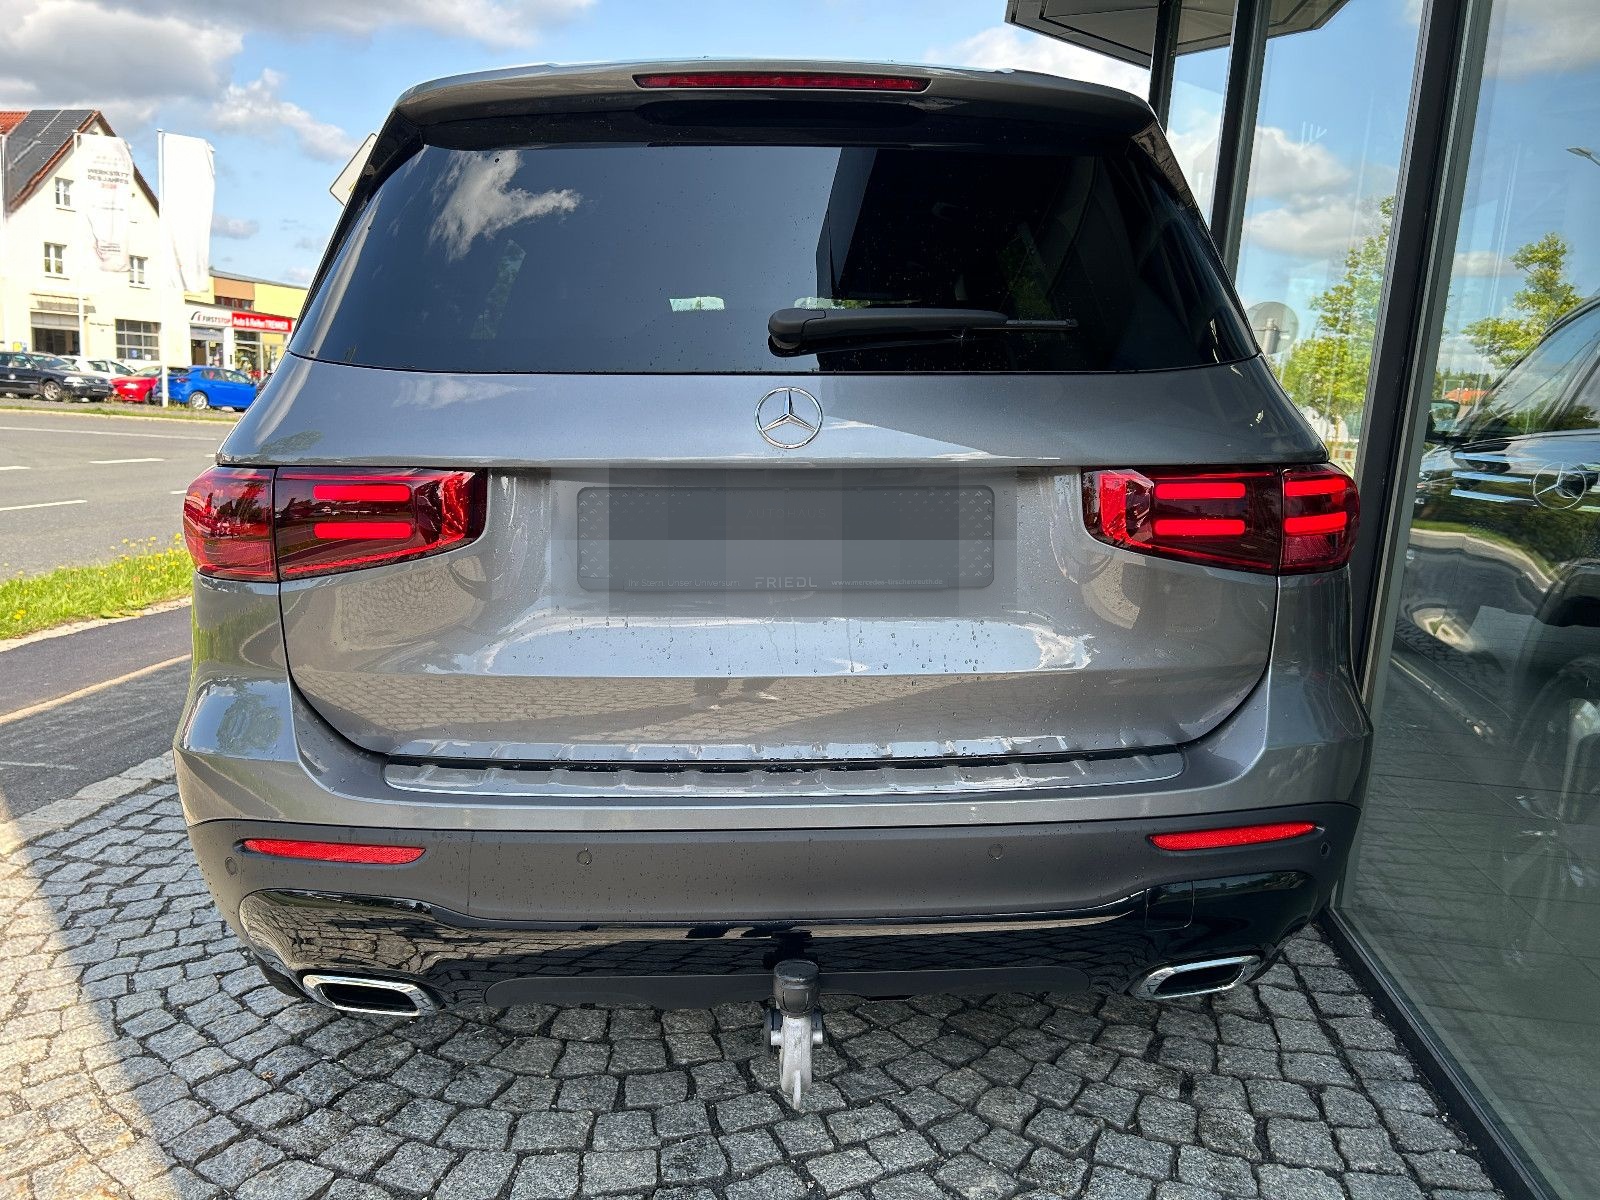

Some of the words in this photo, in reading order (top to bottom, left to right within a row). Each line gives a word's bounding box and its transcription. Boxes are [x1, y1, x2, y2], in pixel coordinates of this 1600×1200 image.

[628, 579, 639, 587] Ihr
[667, 579, 693, 587] Unser
[754, 576, 818, 589] FRIEDL
